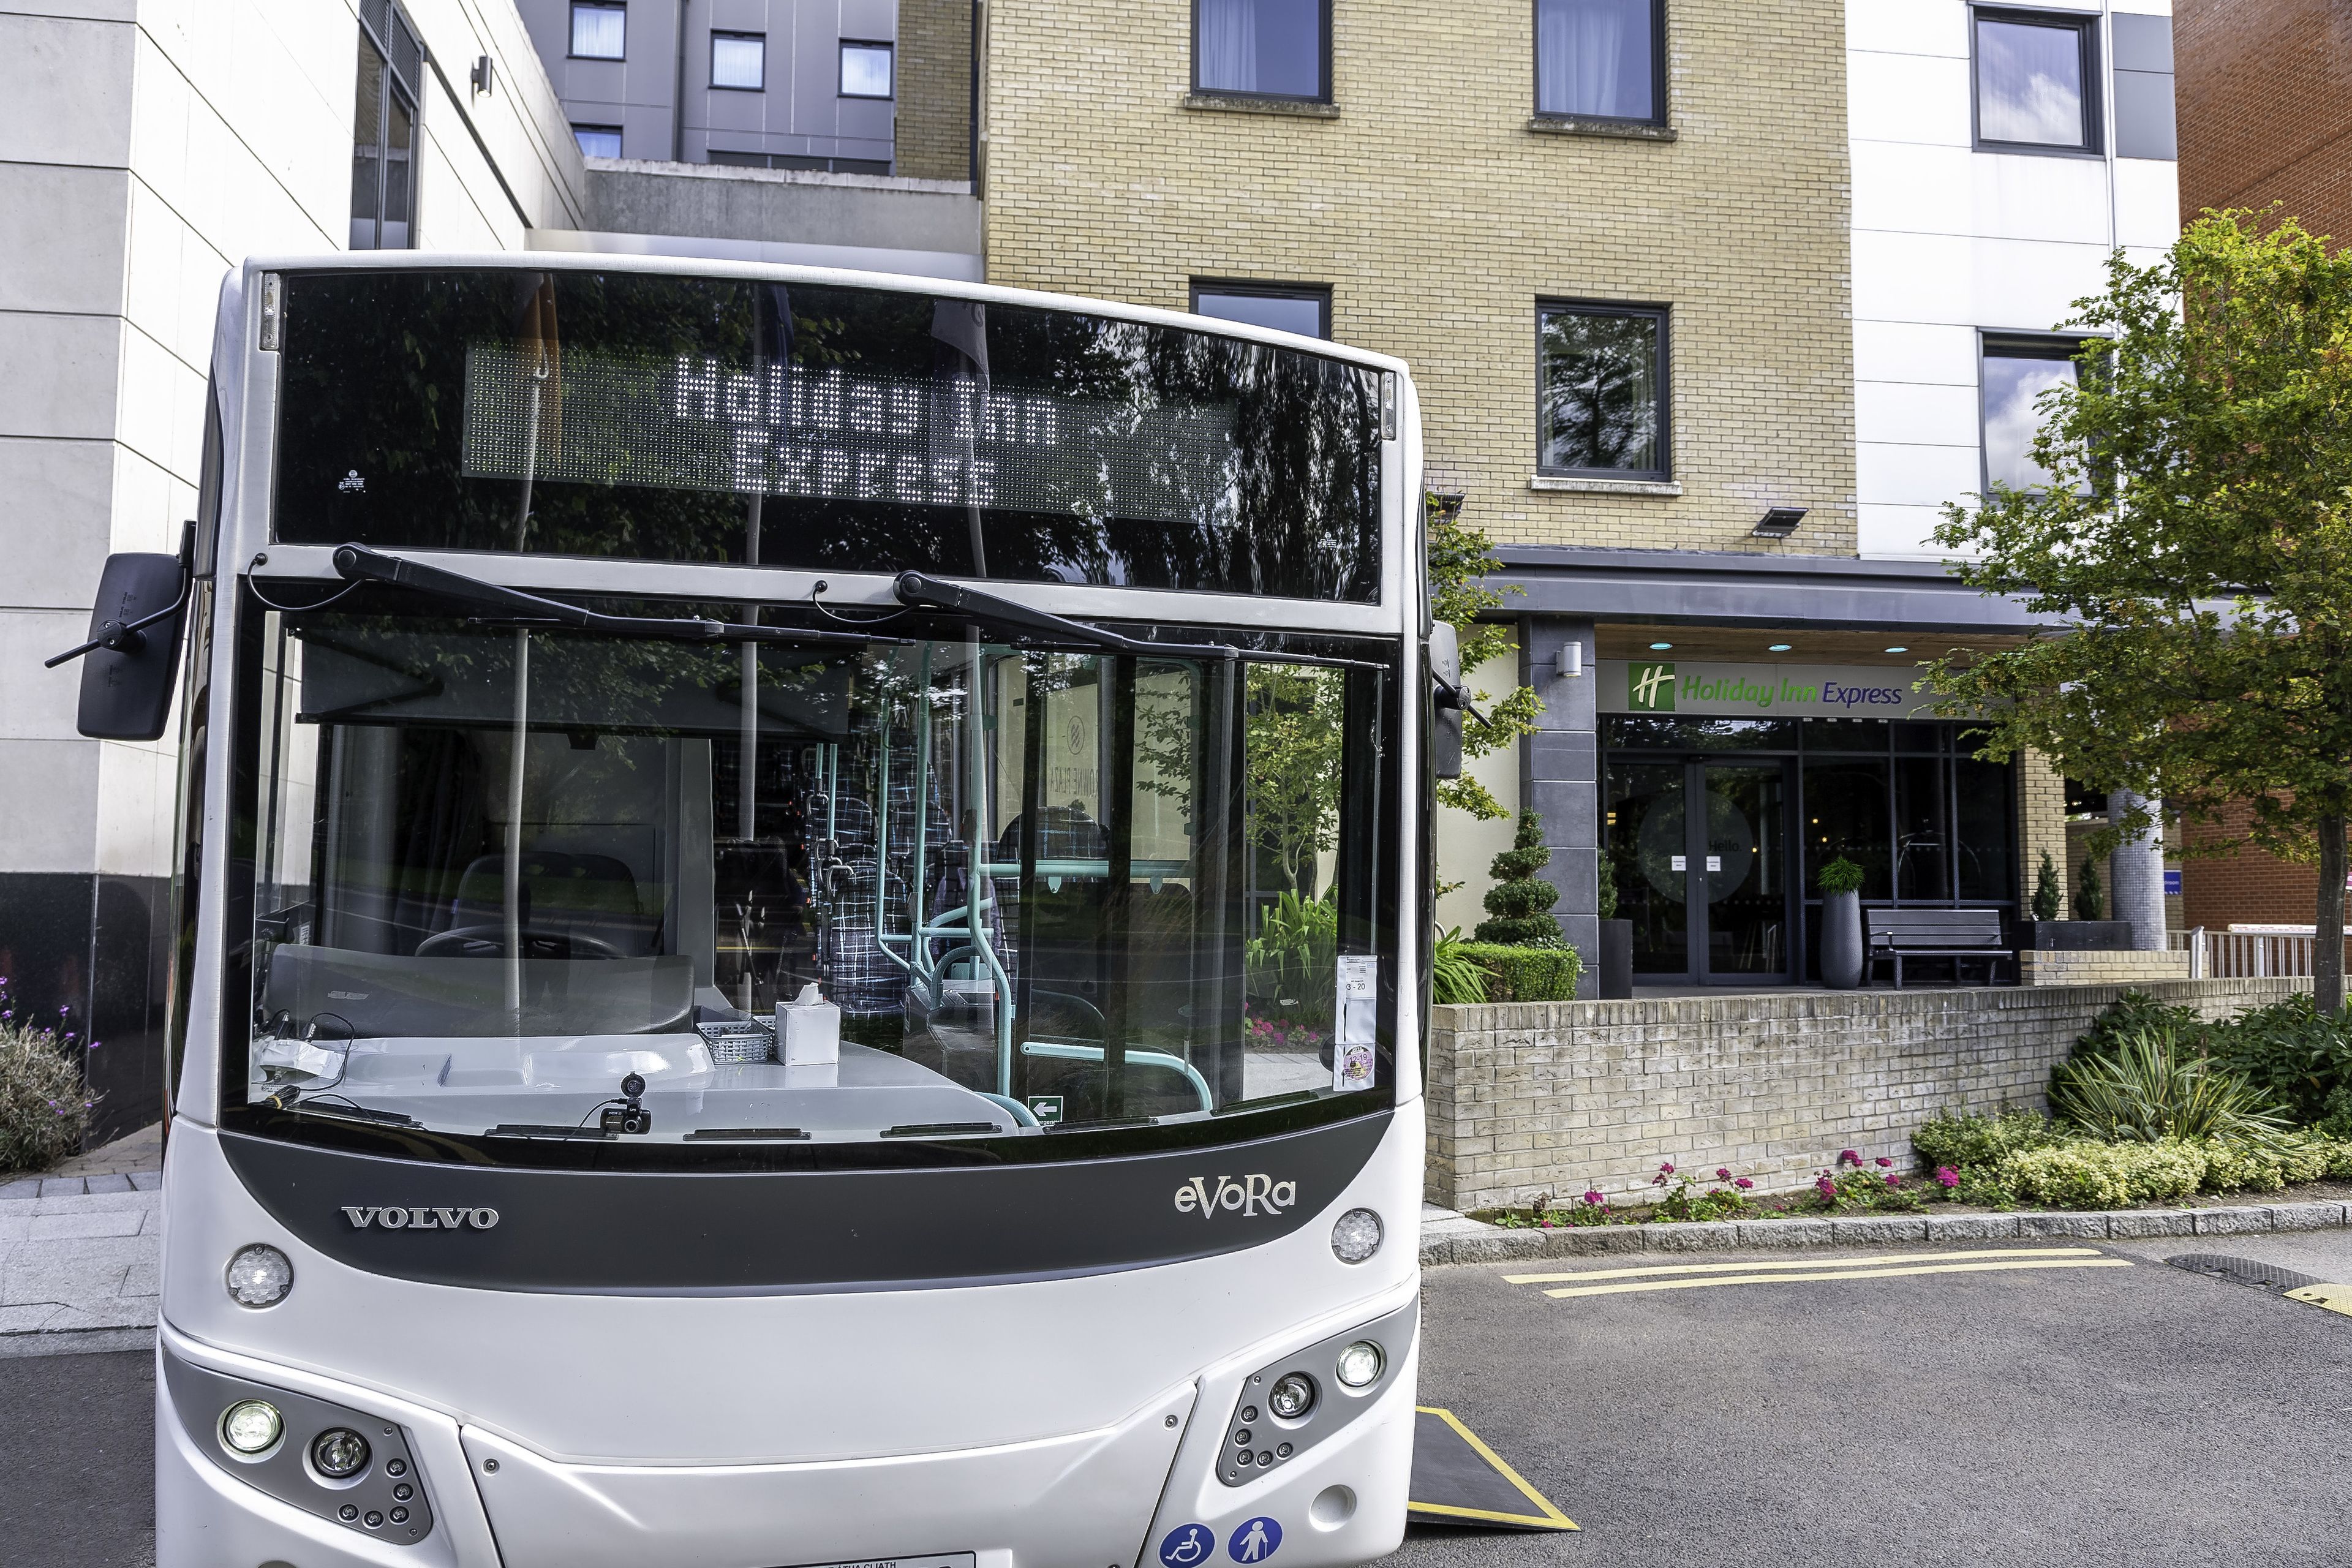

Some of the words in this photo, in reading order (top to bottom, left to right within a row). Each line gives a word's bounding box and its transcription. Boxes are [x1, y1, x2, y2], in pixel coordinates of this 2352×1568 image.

[677, 356, 918, 434] Holiday
[954, 380, 1056, 445] Inn
[735, 429, 995, 506] Express
[1681, 676, 1774, 707] Holiday
[1780, 677, 1817, 703] Inn
[1823, 681, 1903, 709] Express
[1708, 839, 1742, 852] Hello.
[341, 1207, 499, 1229] VOLVO
